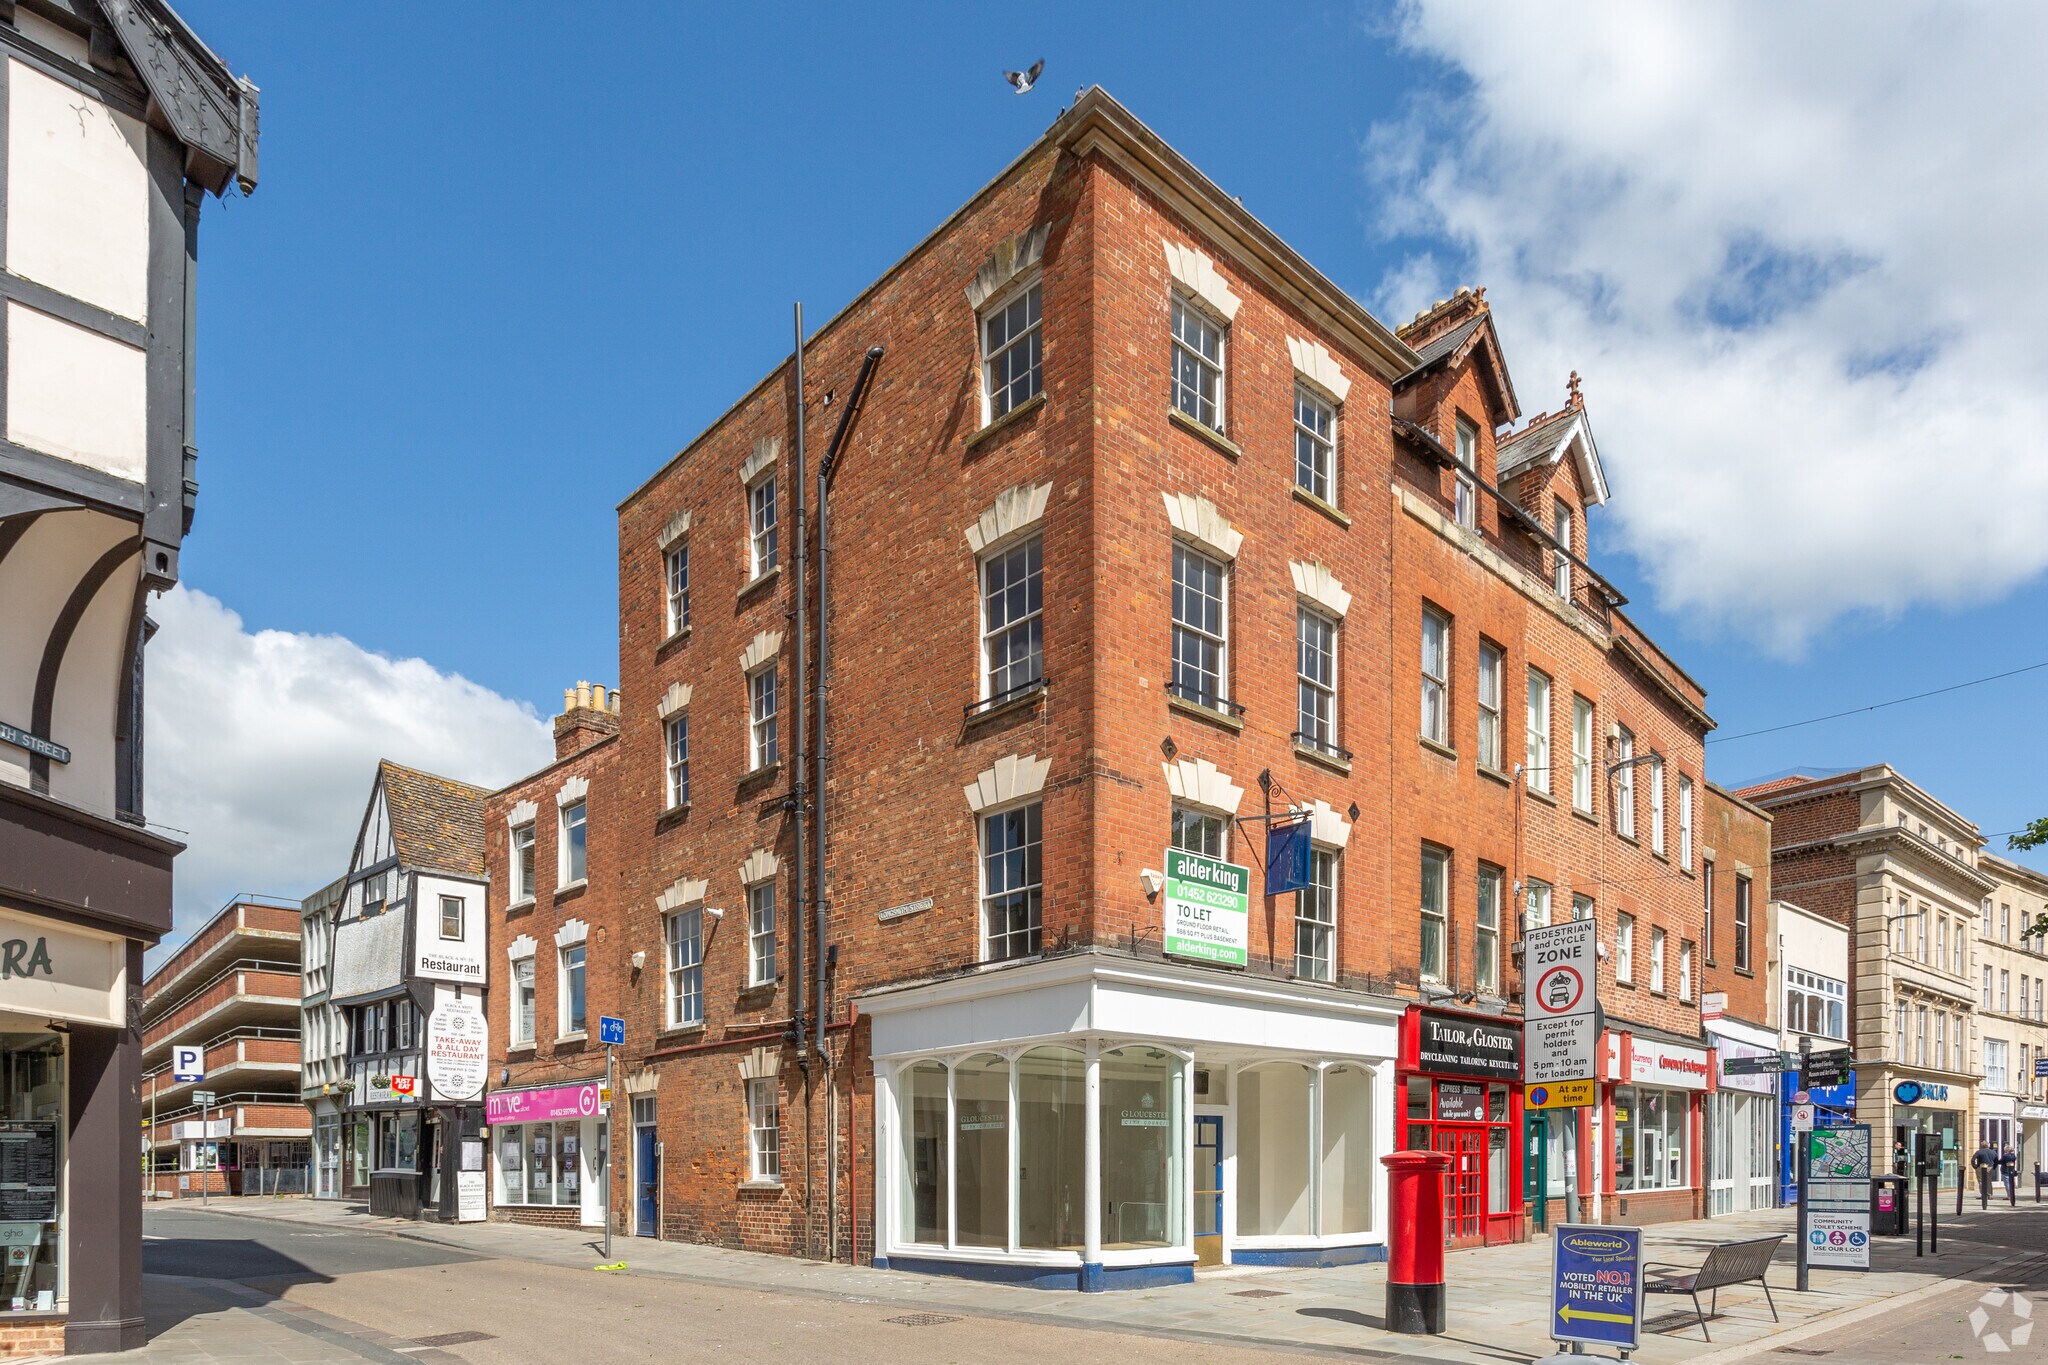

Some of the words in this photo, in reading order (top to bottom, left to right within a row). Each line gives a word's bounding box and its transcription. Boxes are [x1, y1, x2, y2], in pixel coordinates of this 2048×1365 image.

[22, 734, 68, 760] STREET
[1177, 856, 1211, 881] alder
[1212, 863, 1239, 891] king
[1177, 884, 1205, 902] 01452
[1206, 889, 1238, 908] 623290
[1177, 904, 1191, 918] TO
[1193, 908, 1212, 922] LET
[1176, 919, 1196, 928] GROUND
[1197, 922, 1212, 932] FLOOR
[1213, 925, 1229, 935] RETAIL
[1529, 923, 1592, 941] PEDESTRIAN
[1214, 935, 1238, 944] BASEMENT
[1534, 941, 1551, 950] and
[1553, 934, 1586, 947] CYCLE
[1177, 940, 1237, 960] alderking.com
[1537, 946, 1582, 964] ZONE
[421, 957, 480, 974] Restaurant
[1537, 1021, 1568, 1031] Except
[1570, 1019, 1584, 1027] for
[434, 1036, 482, 1045] TAKE-AWAY
[1431, 1021, 1466, 1044] TAILOR
[1466, 1036, 1473, 1047] of
[1473, 1028, 1513, 1051] GLOSTER
[1545, 1029, 1575, 1040] permit
[1543, 1039, 1577, 1049] holders
[431, 1050, 484, 1060] RESTAURANT
[1420, 1052, 1458, 1064] DRYCLEANING
[1460, 1056, 1488, 1067] TAILORING
[1551, 1049, 1568, 1057] and
[180, 1051, 197, 1070] P
[1533, 1062, 1539, 1070] 5
[1540, 1061, 1554, 1070] pm
[1561, 1058, 1571, 1067] 10
[1573, 1058, 1587, 1066] am
[1659, 1054, 1682, 1074] Currency
[1536, 1071, 1549, 1079] for
[1551, 1069, 1584, 1078] loading
[1440, 1084, 1460, 1094] EXPRESS
[1463, 1085, 1481, 1095] SERVICE
[1558, 1085, 1570, 1093] At
[1572, 1084, 1588, 1093] any
[1921, 1083, 1948, 1101] BARCLAYS
[1439, 1097, 1464, 1109] Available
[1563, 1094, 1583, 1102] time
[489, 1095, 521, 1115] move
[961, 1114, 1004, 1123] GLOUCESTER
[1121, 1110, 1168, 1118] GLOUCESTER
[1442, 1110, 1454, 1118] while
[1453, 1111, 1461, 1119] you
[1461, 1109, 1471, 1118] wait!
[3, 1229, 24, 1241] ghd
[1570, 1239, 1622, 1249] Ableworld
[1563, 1272, 1595, 1282] VOTED
[1596, 1270, 1630, 1285] NO.1
[1560, 1281, 1596, 1291] MOBILITY
[1598, 1285, 1633, 1294] RETAILER
[1569, 1290, 1580, 1299] IN
[1584, 1291, 1603, 1301] THE
[1607, 1293, 1623, 1303] UK
